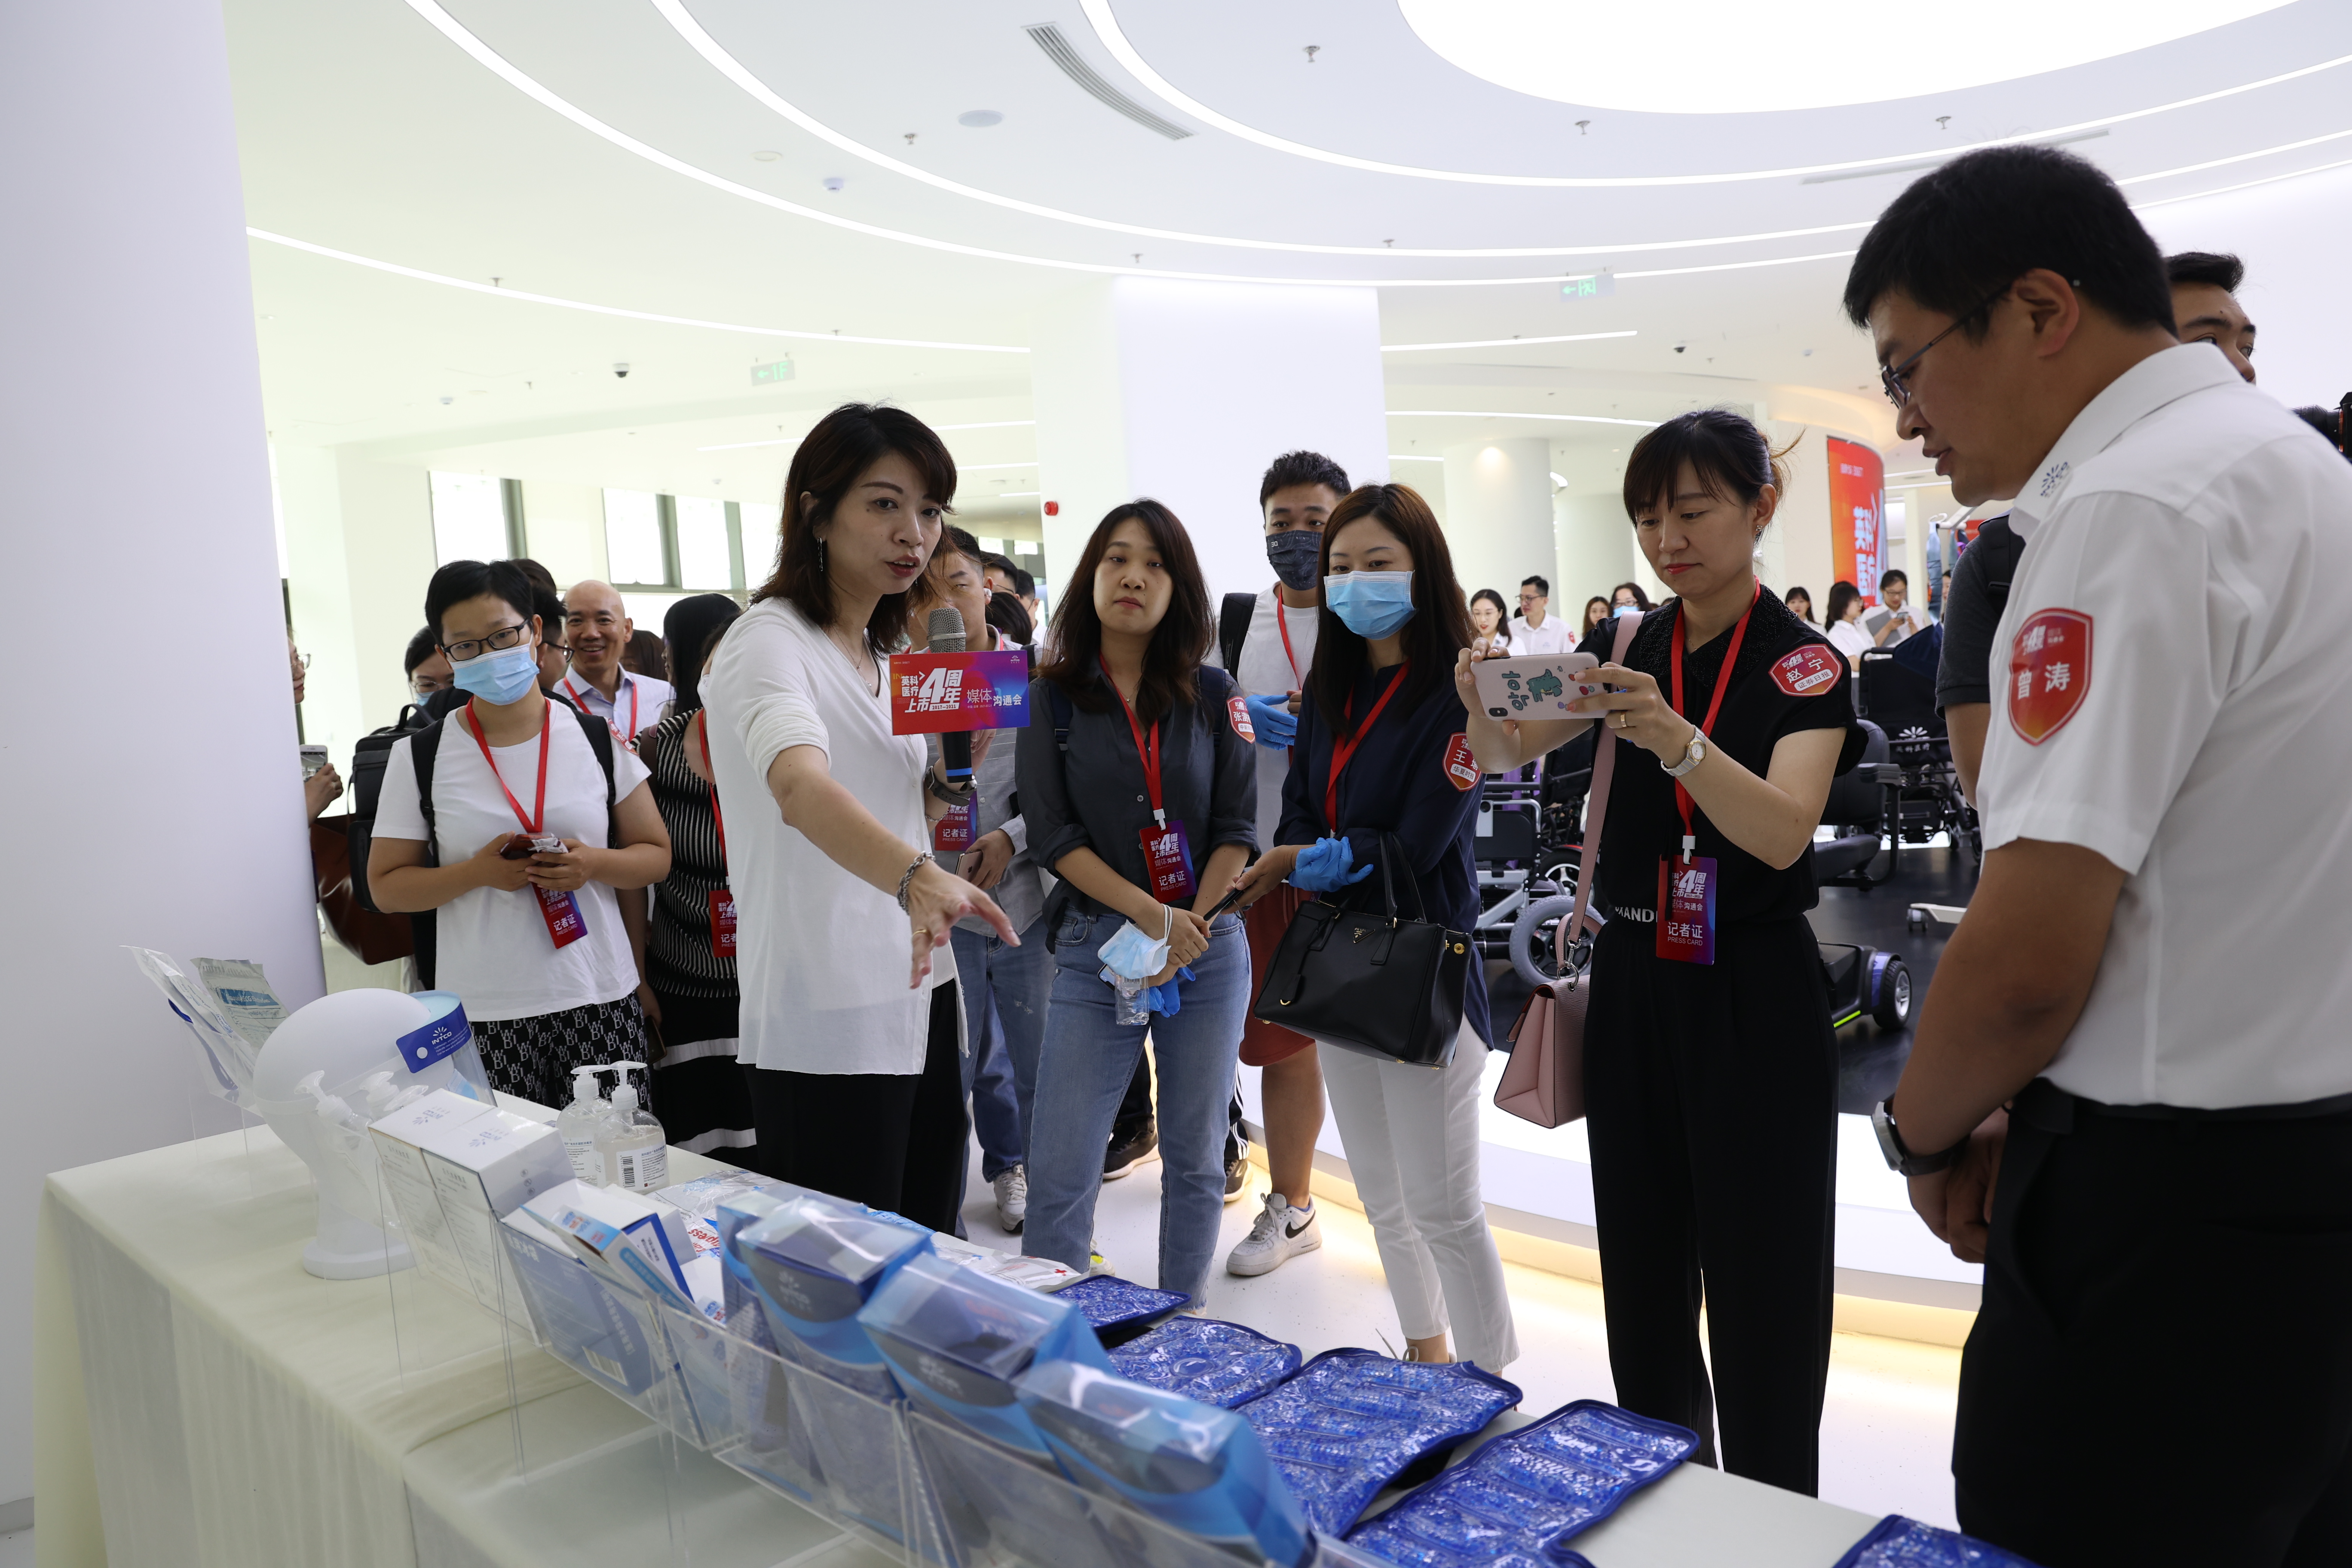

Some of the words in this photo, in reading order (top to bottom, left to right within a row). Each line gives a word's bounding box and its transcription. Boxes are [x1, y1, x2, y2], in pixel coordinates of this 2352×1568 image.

[771, 361, 788, 380] 1F
[901, 675, 919, 686] 英科
[918, 668, 947, 703] 4
[1798, 671, 1831, 689] 证券日报
[902, 686, 919, 697] 医疗
[967, 688, 992, 704] 媒体
[904, 697, 931, 713] 上市
[993, 694, 1022, 706] 沟通会
[1453, 766, 1475, 780] 华夏时报
[942, 828, 968, 837] 记者证
[1155, 849, 1166, 859] 上市
[1167, 855, 1181, 864] 沟通会
[1159, 870, 1186, 886] 记者证
[1678, 869, 1697, 893] 4
[1161, 883, 1175, 891] PRESS
[1684, 902, 1703, 911] 沟通会
[553, 913, 577, 931] 记者证
[556, 928, 568, 937] PRESS
[1667, 922, 1703, 939] 记者证
[1667, 936, 1686, 944] PRESS
[432, 1031, 452, 1045] INTCO
